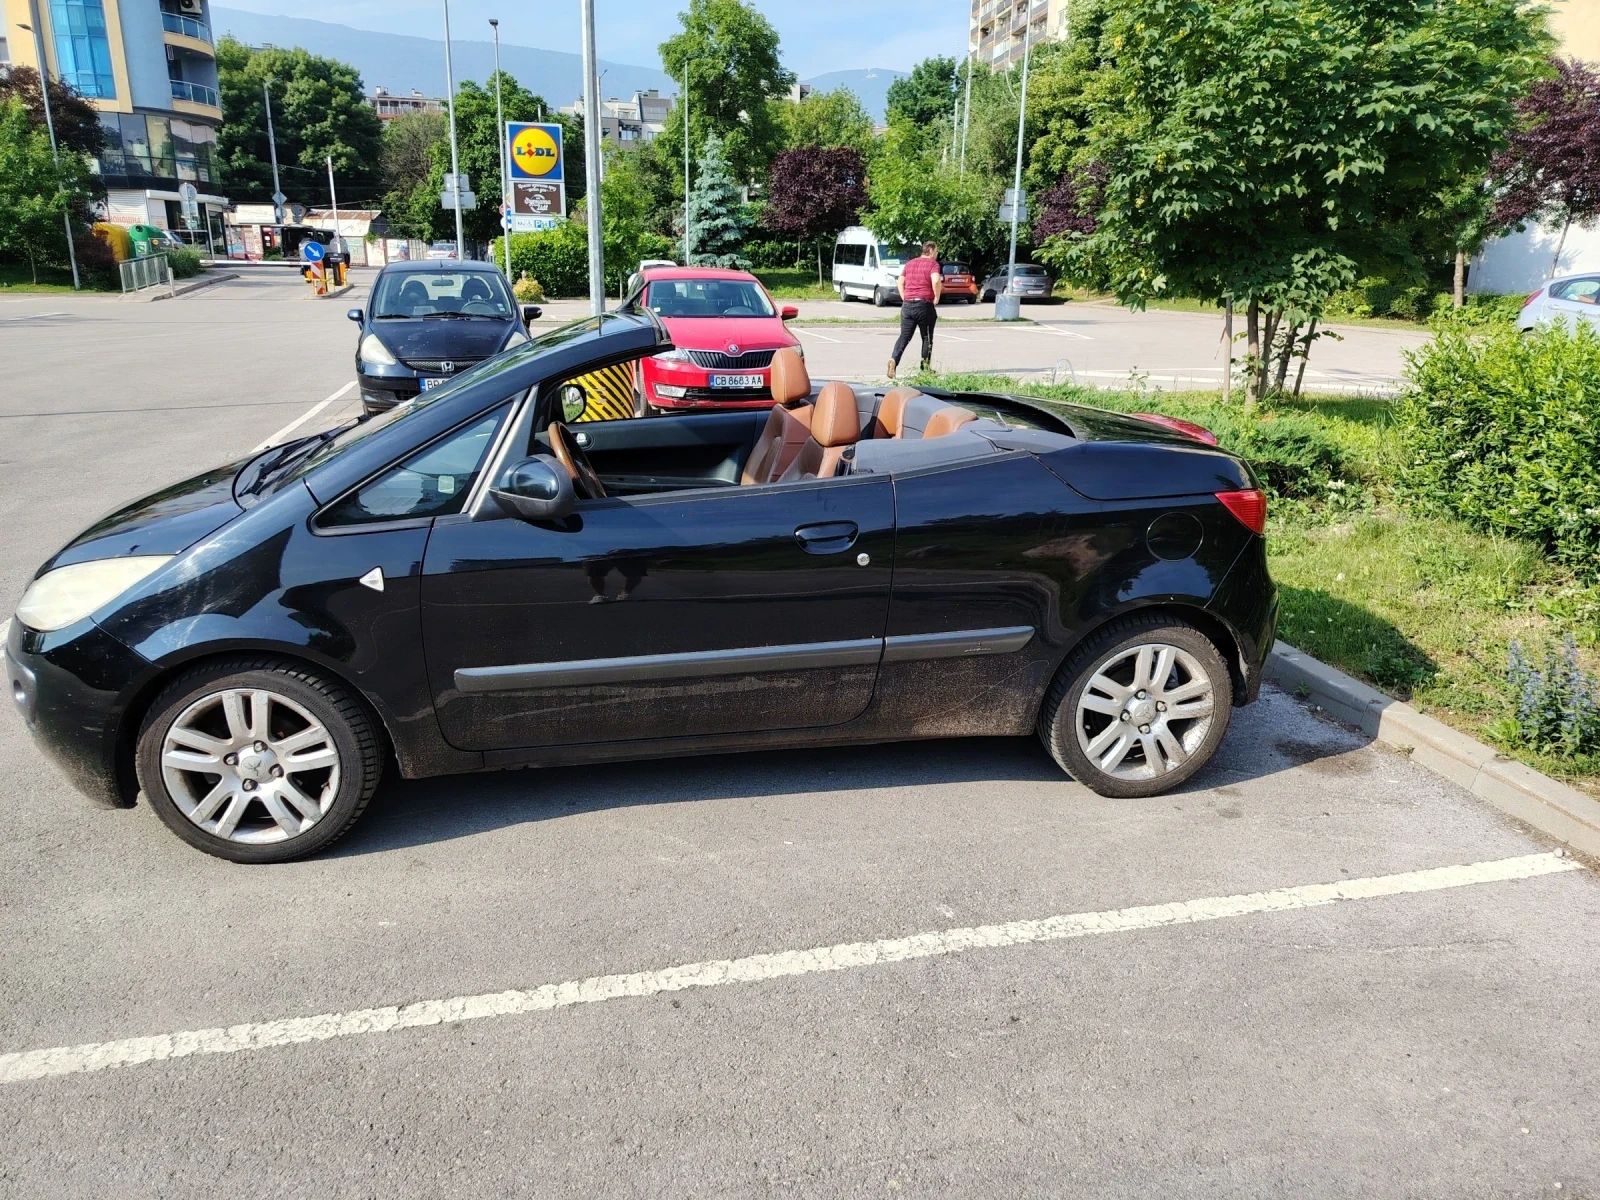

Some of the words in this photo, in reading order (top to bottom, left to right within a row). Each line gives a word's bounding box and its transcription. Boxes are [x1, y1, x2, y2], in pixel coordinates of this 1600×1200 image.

[715, 376, 727, 386] CB
[728, 376, 749, 386] 8683
[752, 375, 762, 385] AA
